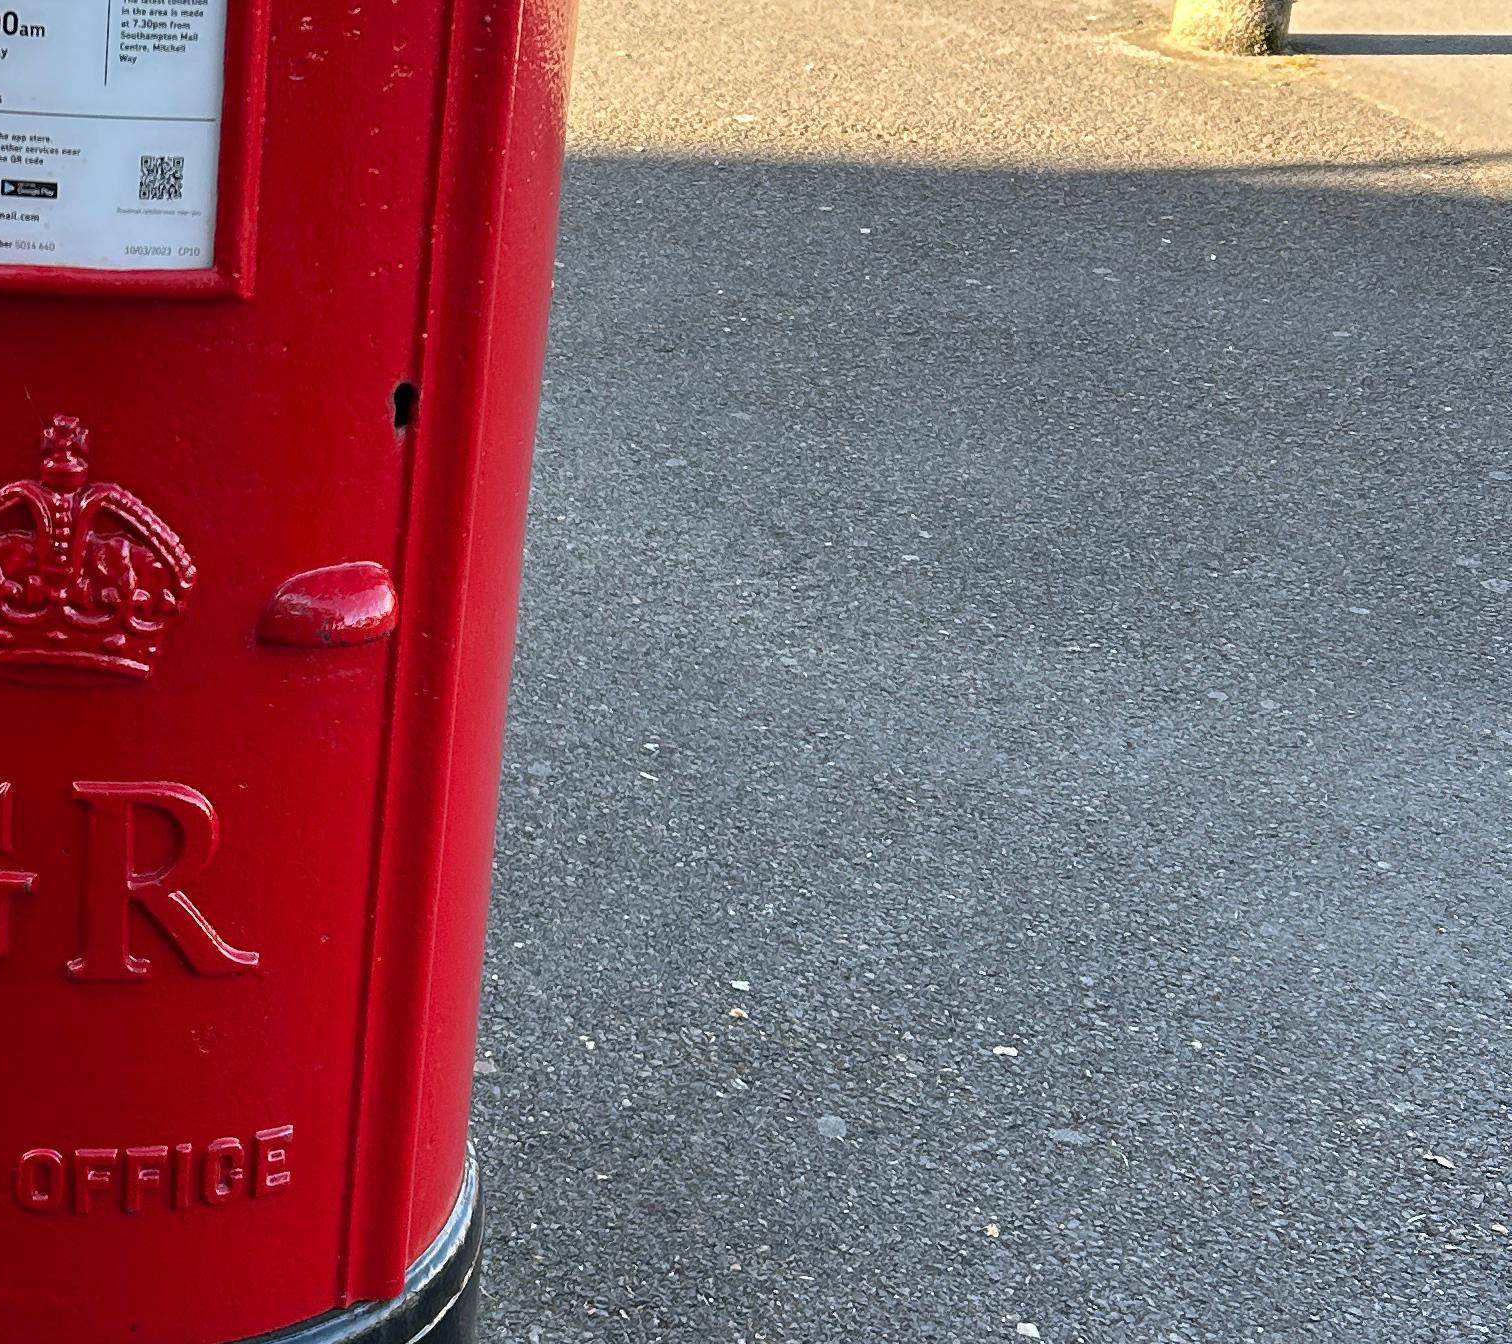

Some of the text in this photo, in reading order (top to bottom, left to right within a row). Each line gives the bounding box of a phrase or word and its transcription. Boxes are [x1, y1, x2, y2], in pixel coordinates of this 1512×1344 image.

[121, 6, 204, 17] in the area is made
[121, 19, 191, 31] at 7.30pm from
[120, 31, 199, 42] Southampton Mail
[119, 54, 138, 64] Way
[11, 133, 27, 143] app
[0, 143, 22, 153] other
[25, 145, 59, 155] services
[61, 148, 81, 156] near
[10, 155, 22, 165] QR
[25, 156, 44, 166] code
[17, 1125, 294, 1214] OFFICE
